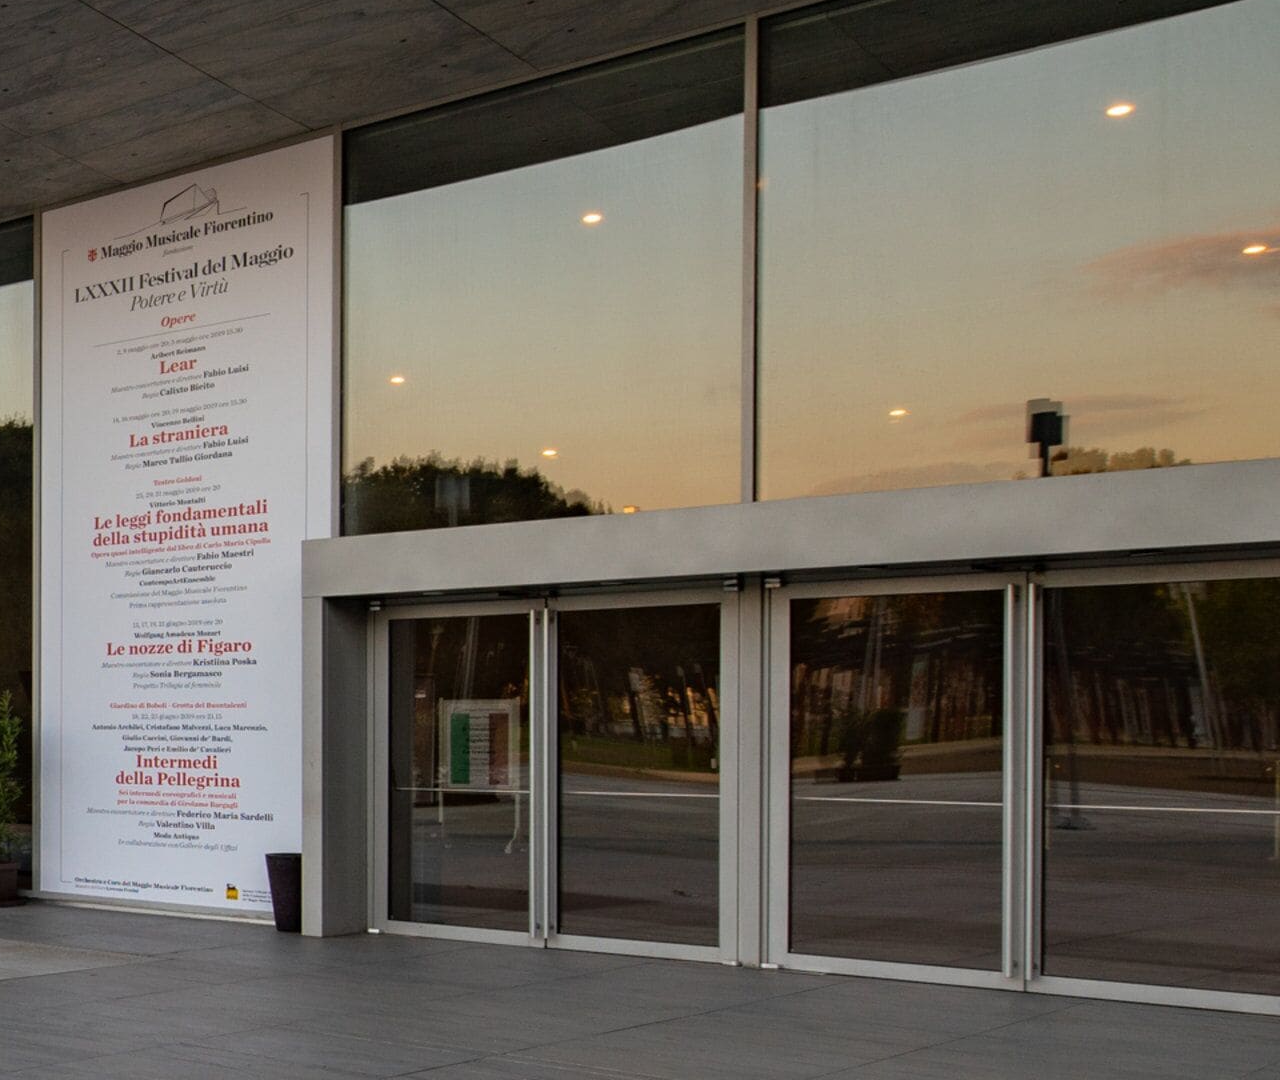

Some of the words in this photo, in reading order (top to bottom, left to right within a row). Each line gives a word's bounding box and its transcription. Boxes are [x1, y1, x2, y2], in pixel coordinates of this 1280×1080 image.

[100, 240, 143, 260] Maggio
[146, 227, 200, 248] Musicale
[203, 210, 274, 235] Fiorentino
[74, 277, 134, 304] LXXXII
[140, 263, 198, 289] Festival
[202, 257, 226, 275] del
[232, 244, 294, 271] Maggio
[130, 291, 176, 312] Potere
[178, 289, 186, 301] e
[190, 278, 228, 299] Virtù
[160, 313, 196, 328] Opere
[160, 358, 197, 375] Lear
[203, 368, 226, 379] Fabio
[228, 364, 249, 374] Luisi
[159, 384, 188, 396] Calixto
[183, 415, 204, 423] Bellini
[129, 434, 148, 448] La
[152, 424, 228, 445] straniera
[203, 439, 226, 449] Fabio
[228, 436, 248, 446] Luisi
[142, 459, 168, 468] Marco
[169, 455, 193, 465] Tullio
[194, 451, 232, 461] Giordana
[176, 475, 202, 484] Goldoni
[150, 500, 176, 508] Vittorio
[94, 517, 112, 530] Le
[116, 512, 152, 529] leggi
[156, 499, 268, 524] fondamentali
[93, 532, 129, 547] della
[133, 524, 206, 544] stupidità
[211, 522, 268, 536] umana
[91, 551, 109, 559] Opera
[223, 539, 244, 547] Maria
[197, 550, 219, 560] Fabio
[221, 548, 254, 559] Maestri
[142, 566, 180, 576] Giancarlo
[182, 562, 232, 572] Cauteruccio
[134, 632, 164, 640] Wolfgang
[107, 643, 125, 656] Le
[129, 643, 173, 654] nozze
[177, 640, 192, 653] di
[197, 639, 252, 656] Figaro
[174, 670, 222, 680] Bergamasco
[136, 754, 218, 769] Intermedi
[116, 771, 152, 785] della
[158, 773, 240, 790] Pellegrina
[177, 810, 211, 819] Federico
[213, 811, 238, 819] Maria
[240, 813, 273, 821] Sardelli
[156, 821, 194, 829] Valentino
[196, 822, 215, 830] Villa
